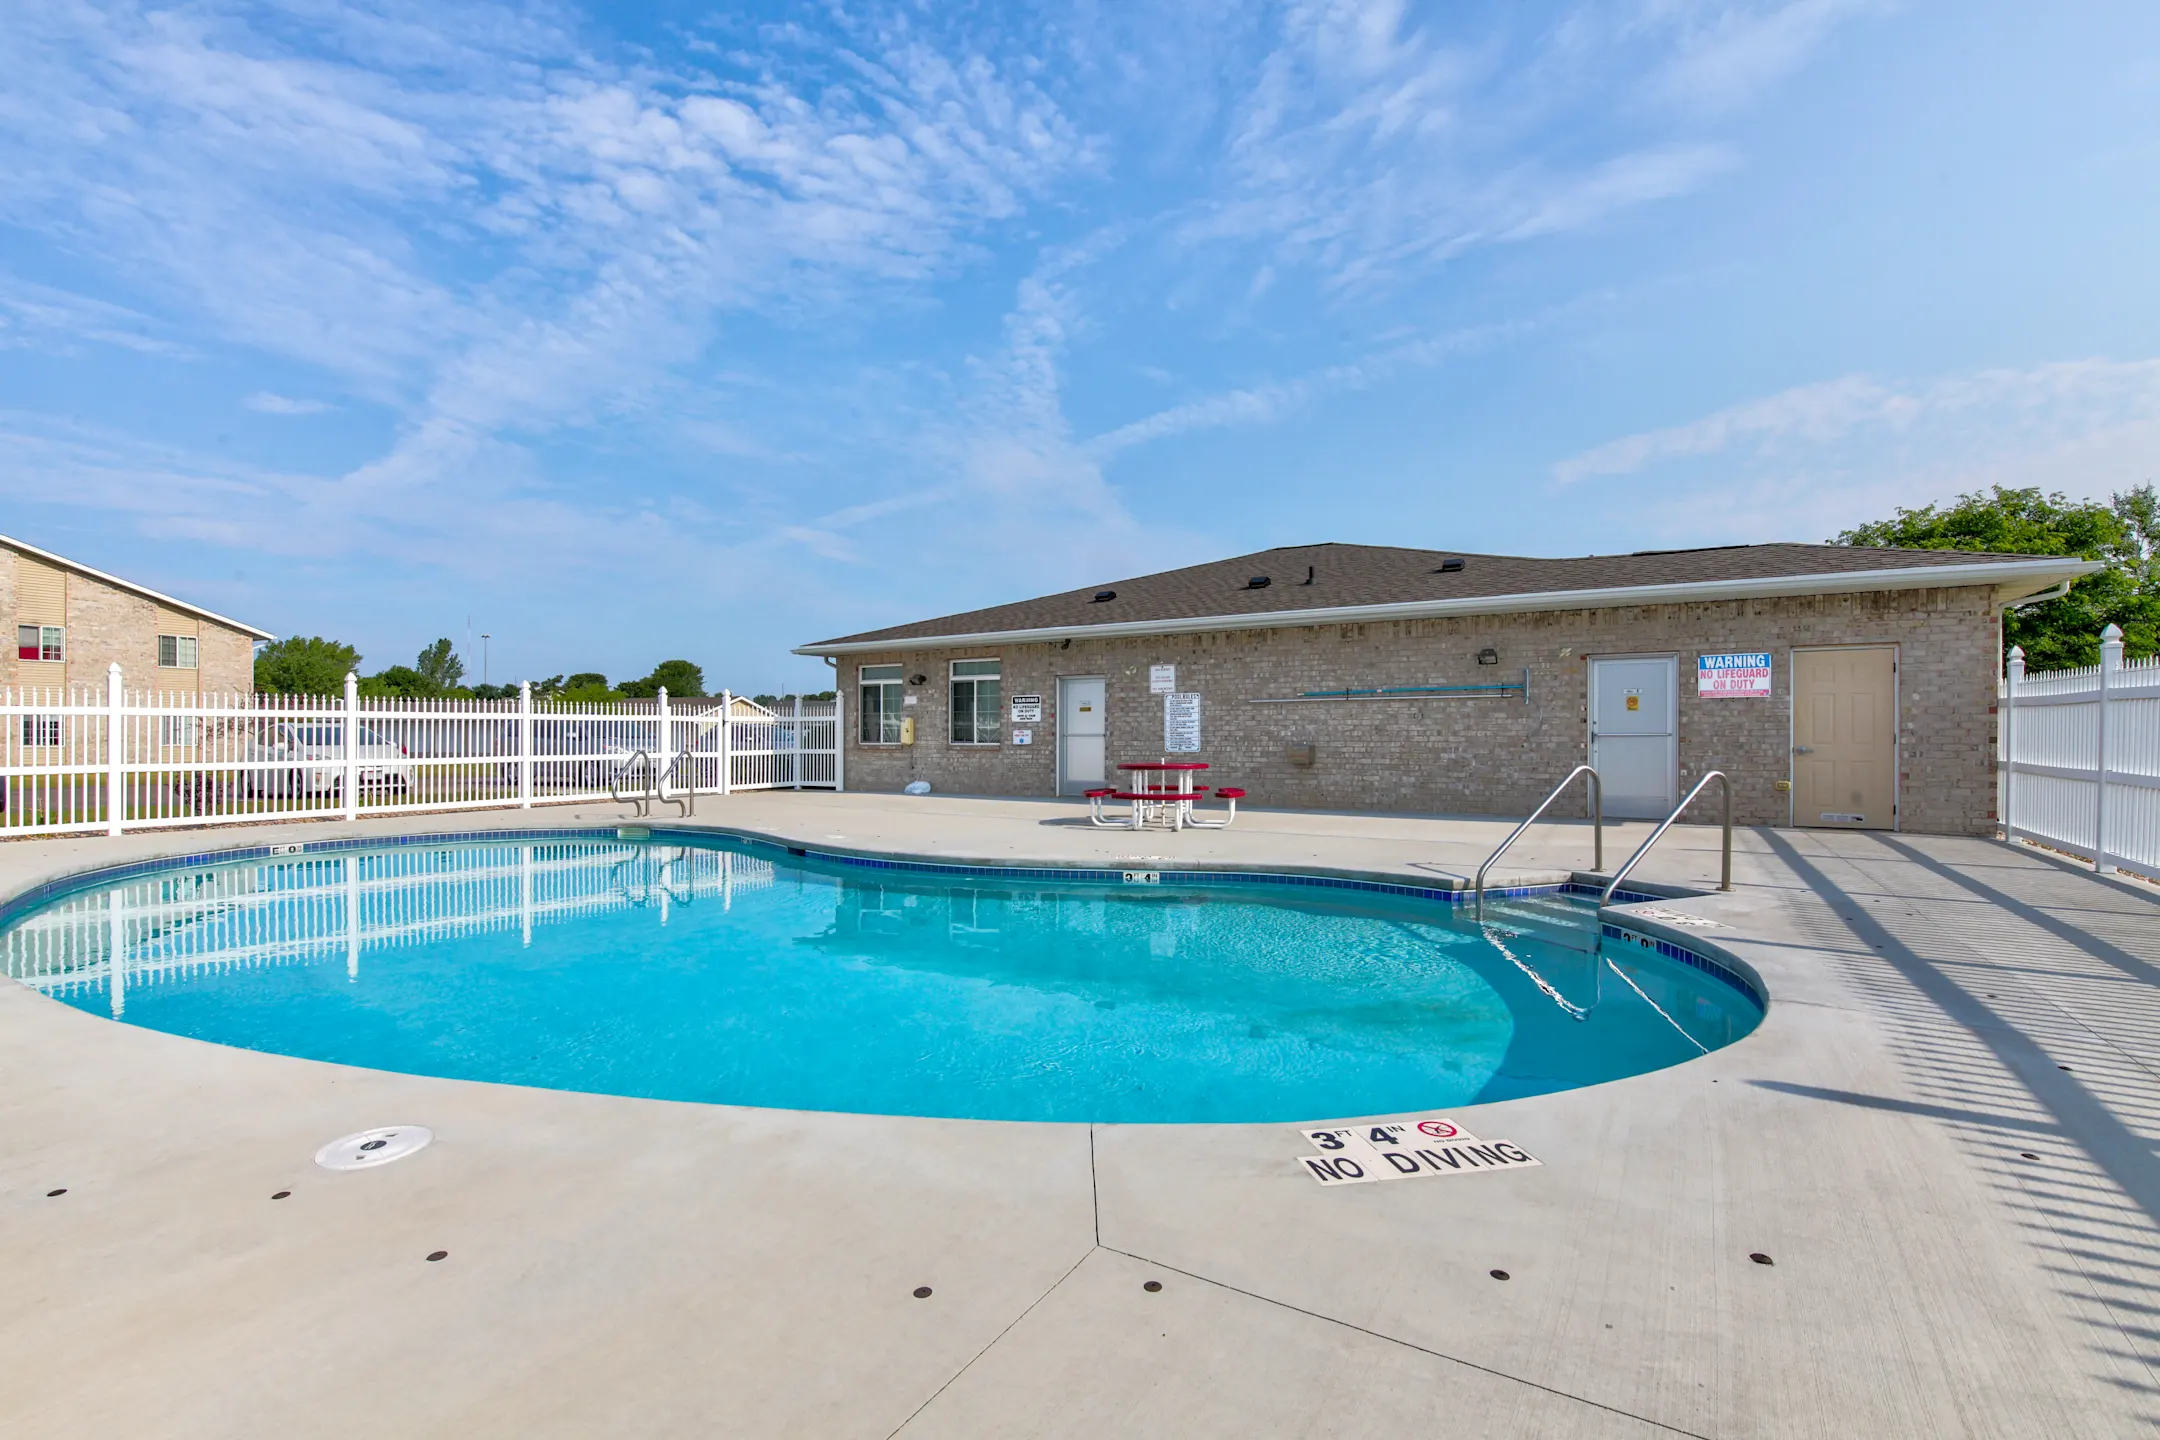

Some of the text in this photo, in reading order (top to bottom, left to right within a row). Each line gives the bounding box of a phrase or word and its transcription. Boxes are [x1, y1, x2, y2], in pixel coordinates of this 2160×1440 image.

[1704, 654, 1765, 669] WARNING
[1700, 668, 1769, 679] NO LIFEGUARD
[1713, 678, 1755, 690] ON DUTY
[1311, 1125, 1407, 1150] 3 FT 4 IN
[1306, 1142, 1533, 1182] NO DIVING
